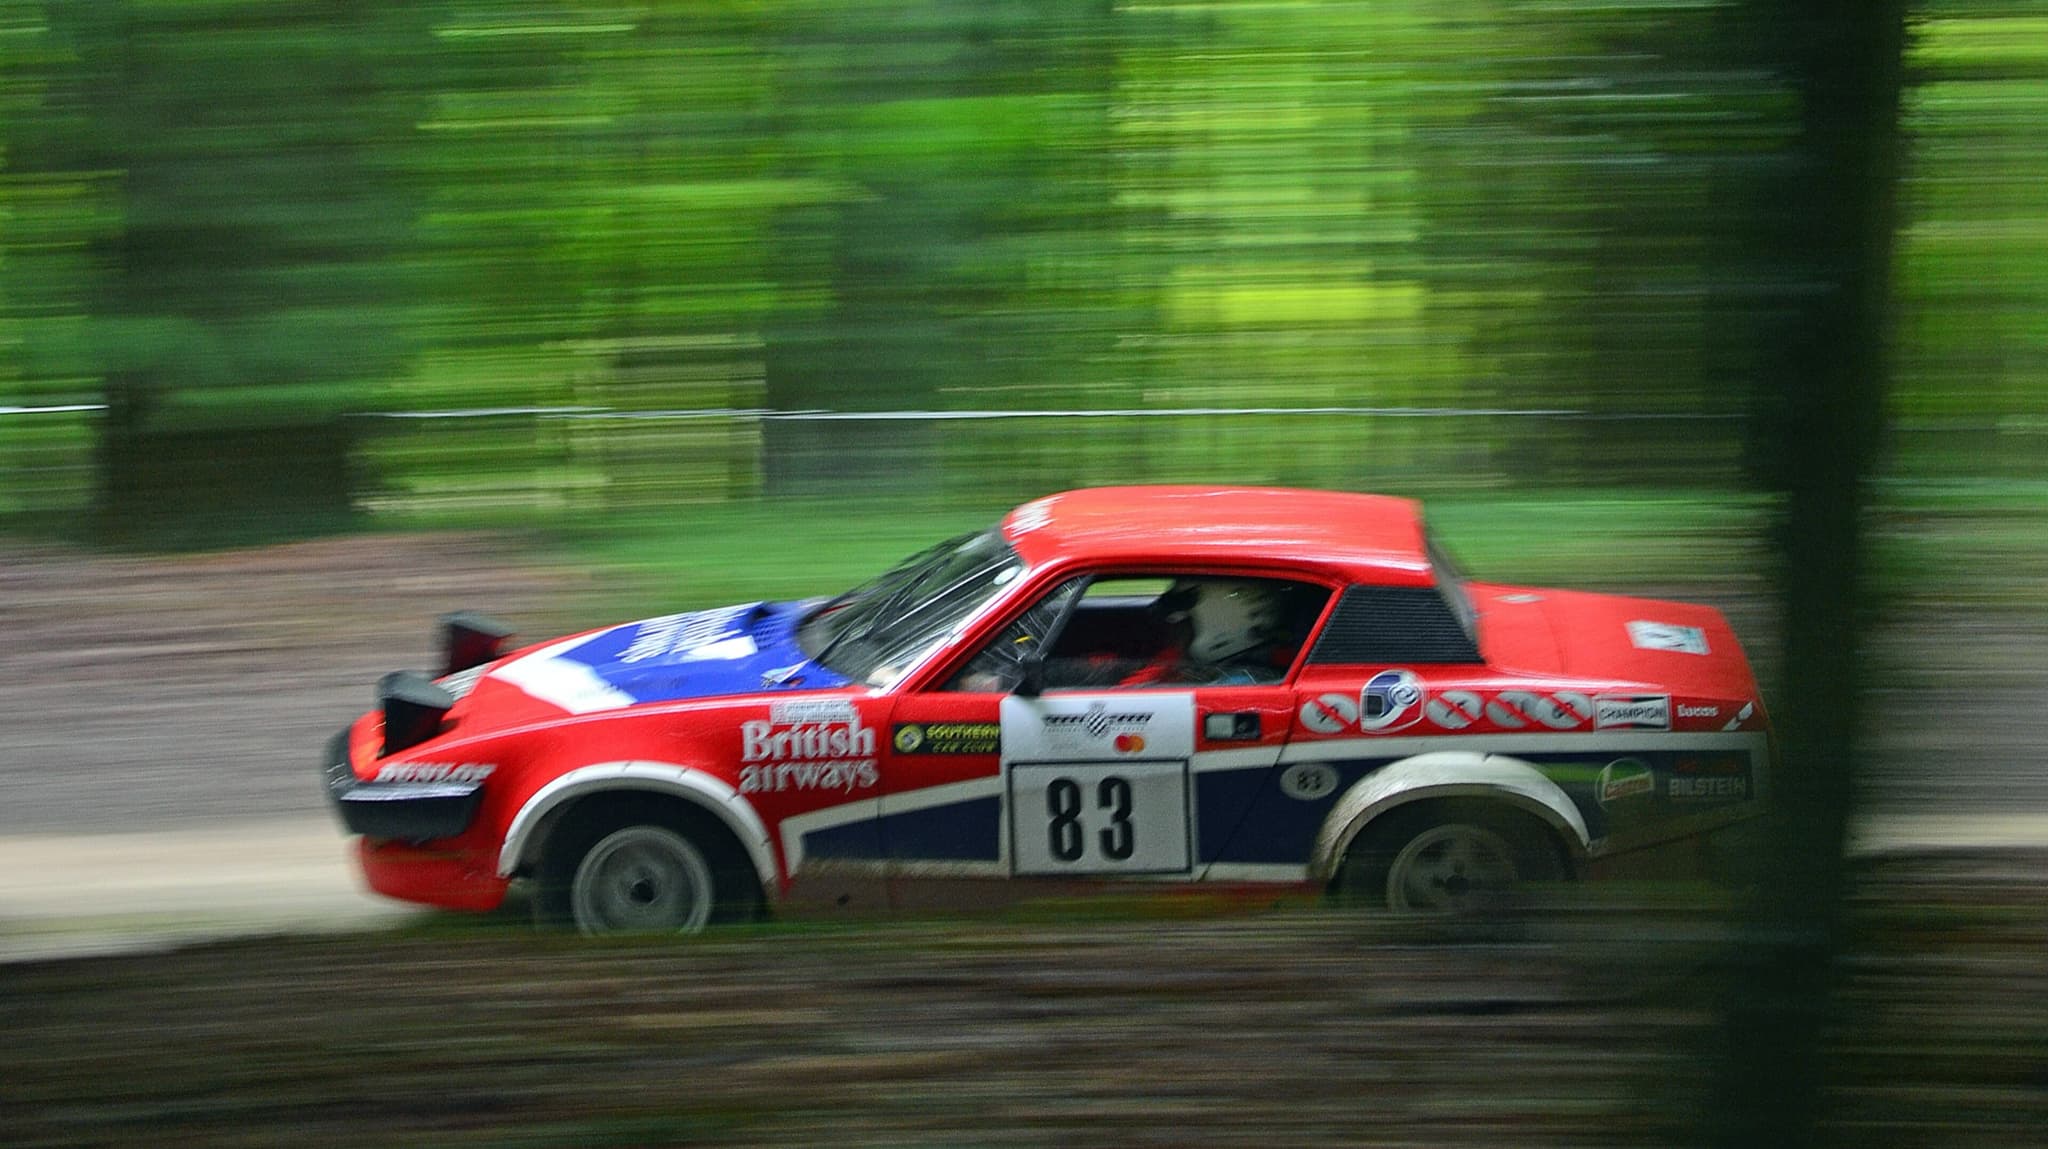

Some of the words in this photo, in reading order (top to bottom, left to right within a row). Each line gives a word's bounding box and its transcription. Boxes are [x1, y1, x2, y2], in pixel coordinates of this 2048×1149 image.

[1600, 706, 1666, 720] CHAMPION
[1677, 704, 1719, 718] Lucas
[740, 718, 876, 762] British
[926, 723, 999, 739] SOUTHERN
[740, 759, 879, 794] airways
[1669, 777, 1747, 797] BILSTEIN
[1047, 776, 1134, 861] 83
